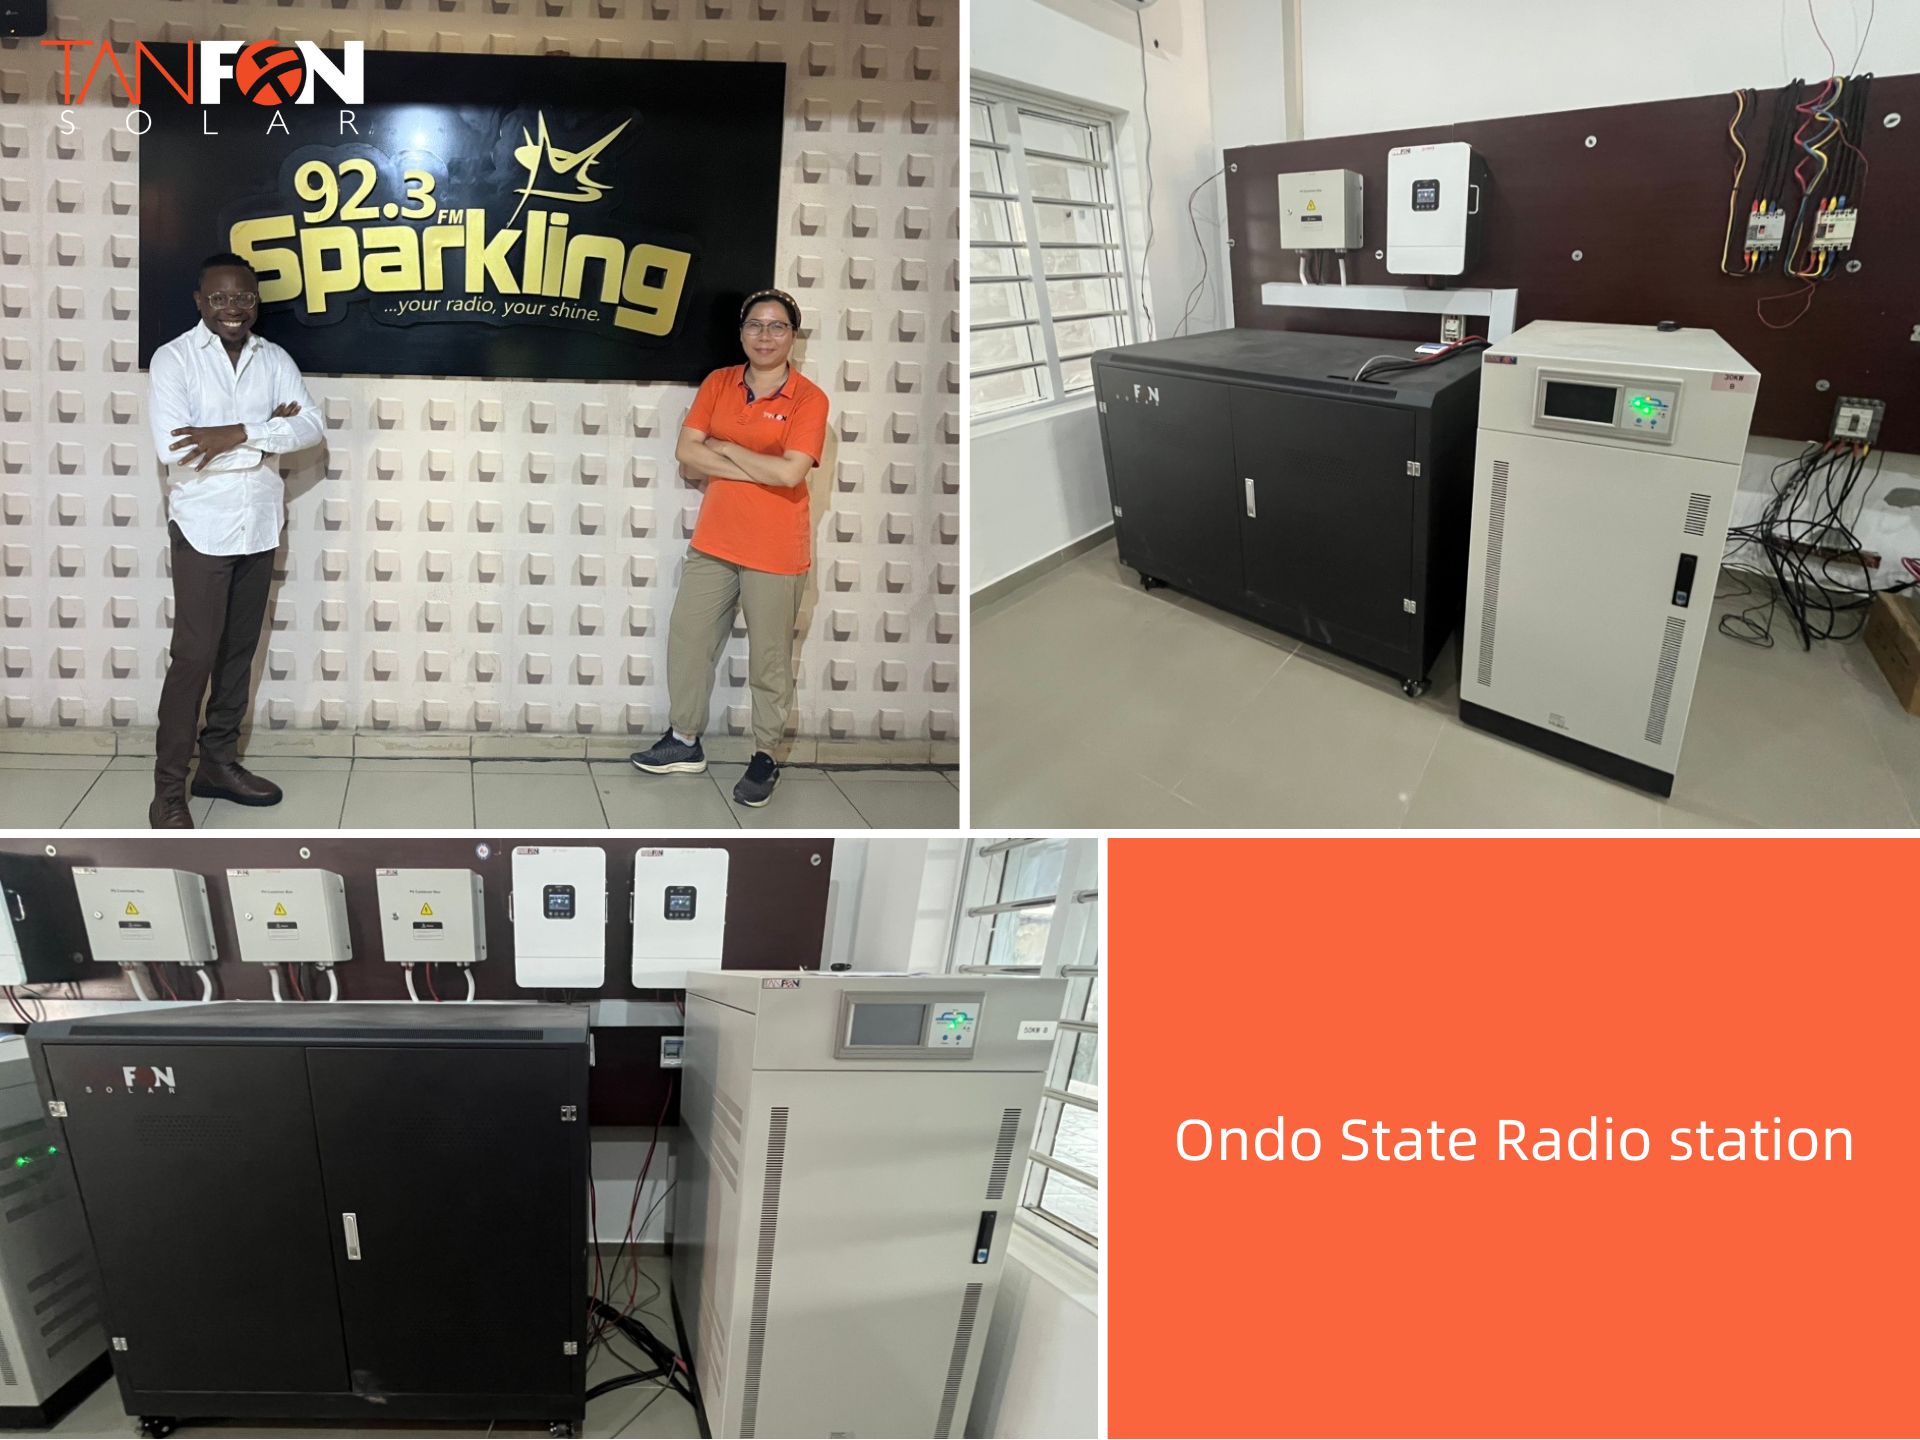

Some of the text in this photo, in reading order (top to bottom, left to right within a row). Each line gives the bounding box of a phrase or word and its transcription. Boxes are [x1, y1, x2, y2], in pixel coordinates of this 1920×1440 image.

[293, 157, 437, 224] 92.3
[437, 208, 464, 225] FM
[229, 208, 692, 337] Sparkling
[446, 296, 498, 314] radio,
[501, 301, 546, 318] your
[549, 302, 601, 322] shine.
